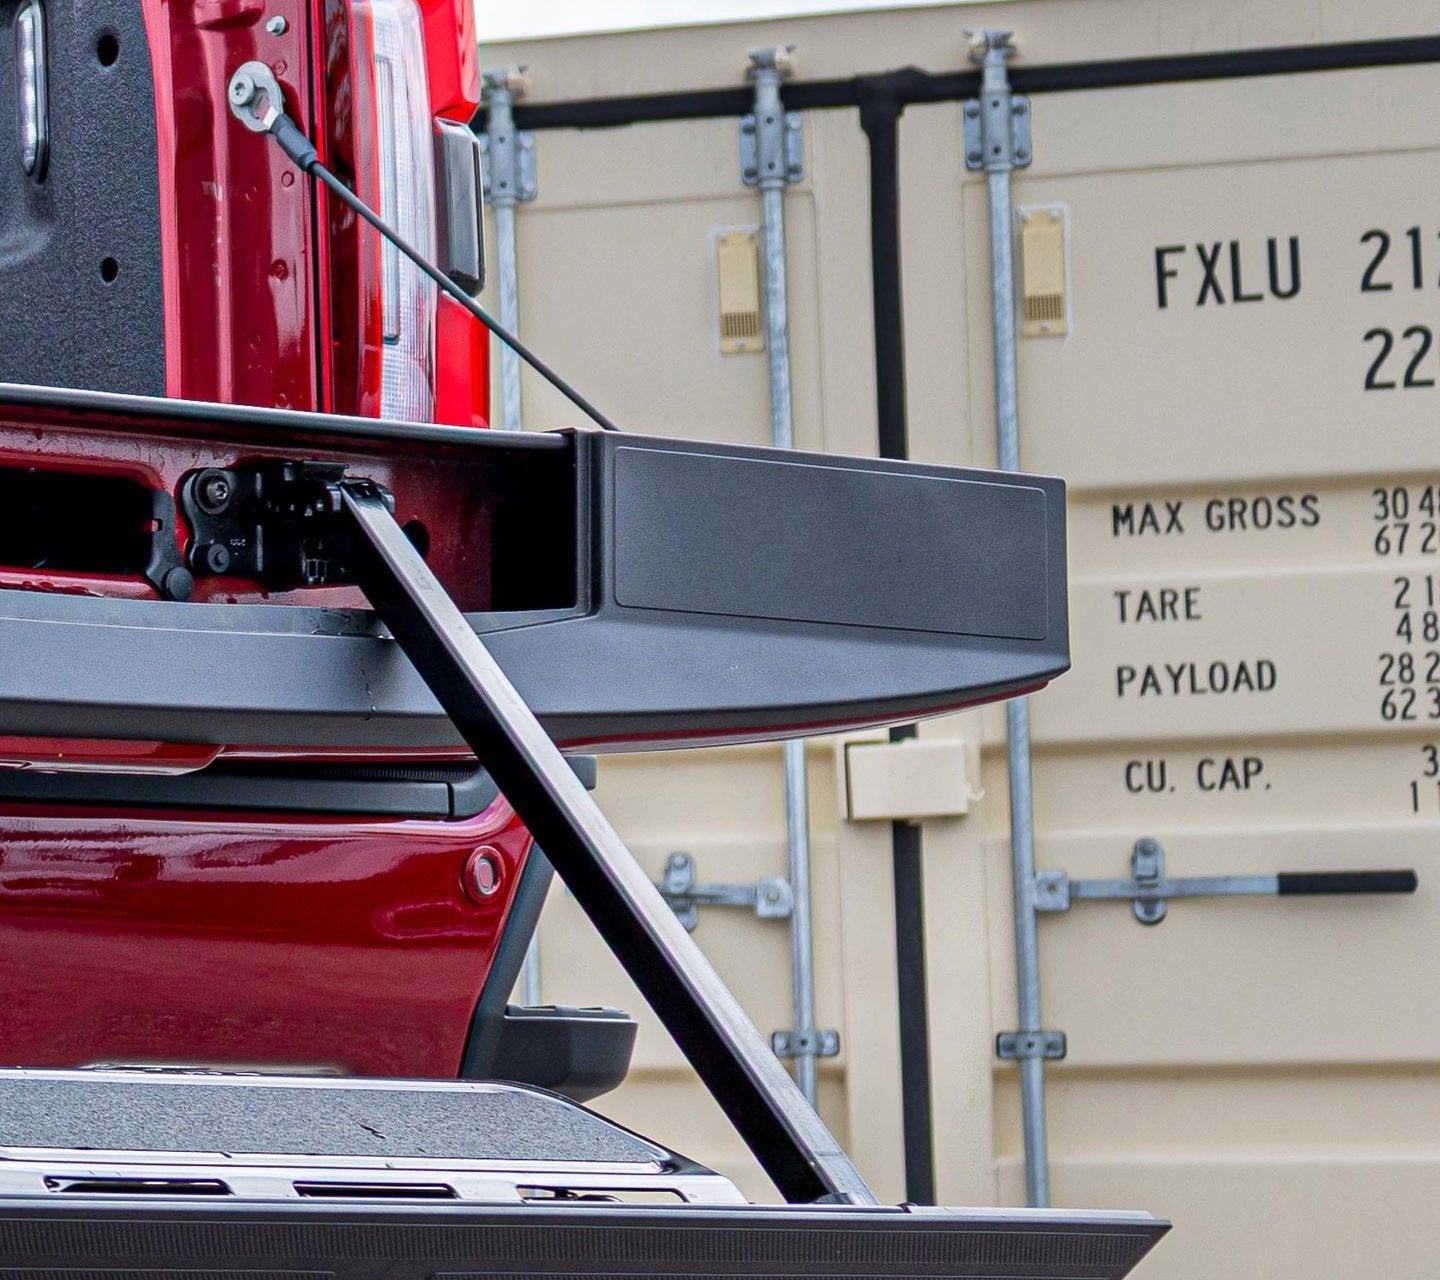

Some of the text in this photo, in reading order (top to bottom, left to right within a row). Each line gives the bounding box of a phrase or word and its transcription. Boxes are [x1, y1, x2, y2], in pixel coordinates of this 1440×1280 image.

[1155, 224, 1440, 308] FXLU 21
[1112, 501, 1184, 537] MAX
[1205, 494, 1321, 532] GROSS
[1419, 485, 1440, 518] 4
[1114, 587, 1202, 623] TARE
[1116, 659, 1278, 697] PAYLOAD
[1125, 758, 1176, 793] CU.
[1197, 756, 1271, 791] CAP.
